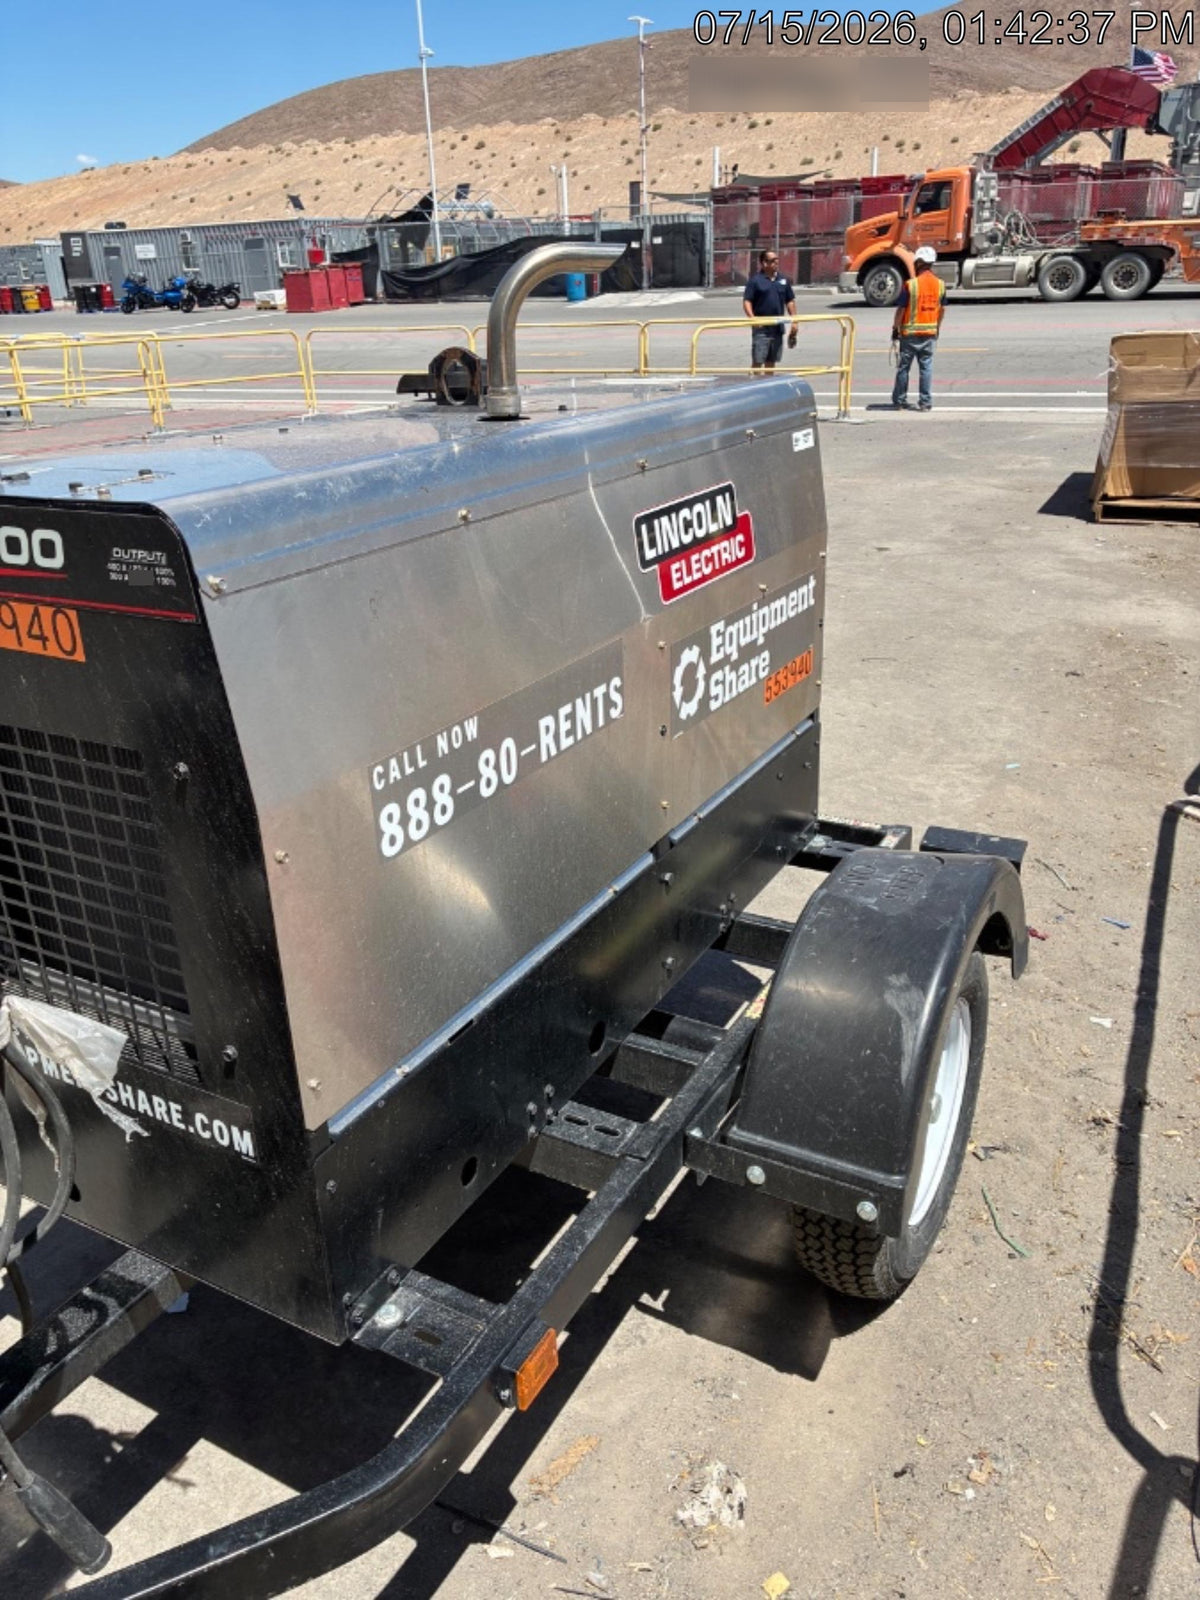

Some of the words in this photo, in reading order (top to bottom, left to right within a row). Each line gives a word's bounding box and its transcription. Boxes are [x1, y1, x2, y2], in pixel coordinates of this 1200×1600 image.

[640, 491, 734, 561] LINCOLN
[670, 532, 746, 590] ELECTRIC
[709, 574, 817, 665] Equipment
[709, 650, 771, 712] Share
[764, 650, 813, 704] 553940
[372, 744, 428, 791] CALL
[436, 715, 480, 758] NOW
[379, 676, 625, 858] 888-80-RENTS
